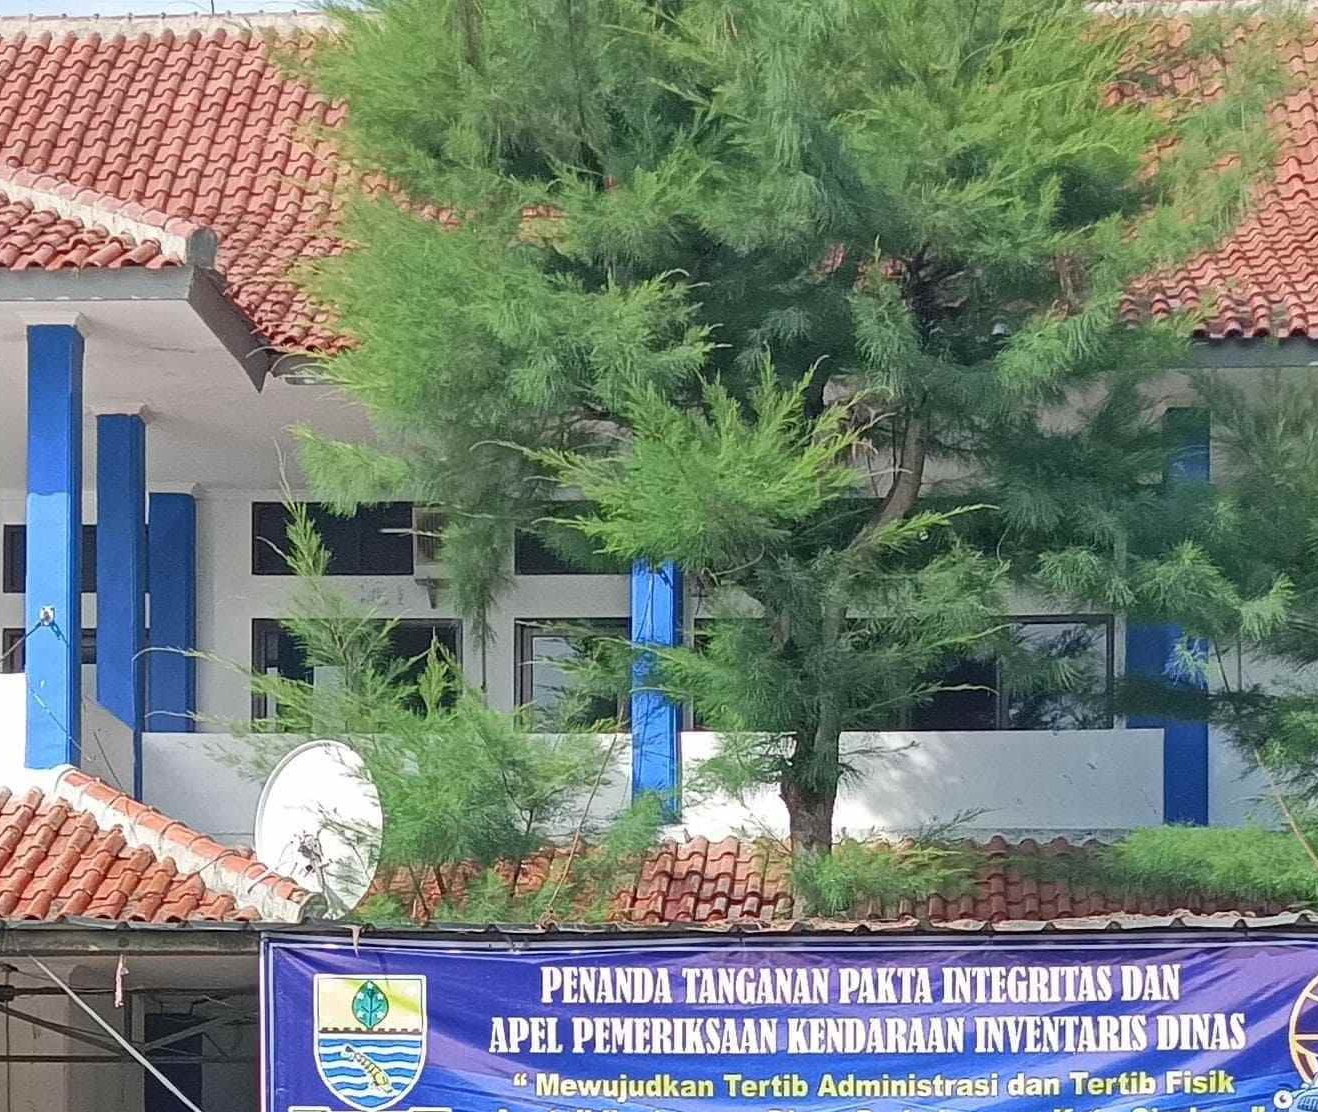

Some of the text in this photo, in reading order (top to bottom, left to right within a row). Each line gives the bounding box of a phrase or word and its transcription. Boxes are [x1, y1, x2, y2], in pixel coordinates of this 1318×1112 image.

[541, 964, 1181, 1005] PENANDA TANGANAN PAKTA INTEGRITAS DAN
[489, 1012, 1247, 1054] APEL PEMERIKSAAN KENDARAAN INVENTARIS DINAS
[535, 1073, 714, 1104] Mewujudkan
[724, 1073, 809, 1097] Tertib
[817, 1073, 999, 1098] Administrasi
[1008, 1072, 1061, 1097] dan
[1069, 1071, 1156, 1096] Tertib
[1166, 1069, 1236, 1094] Fisik
